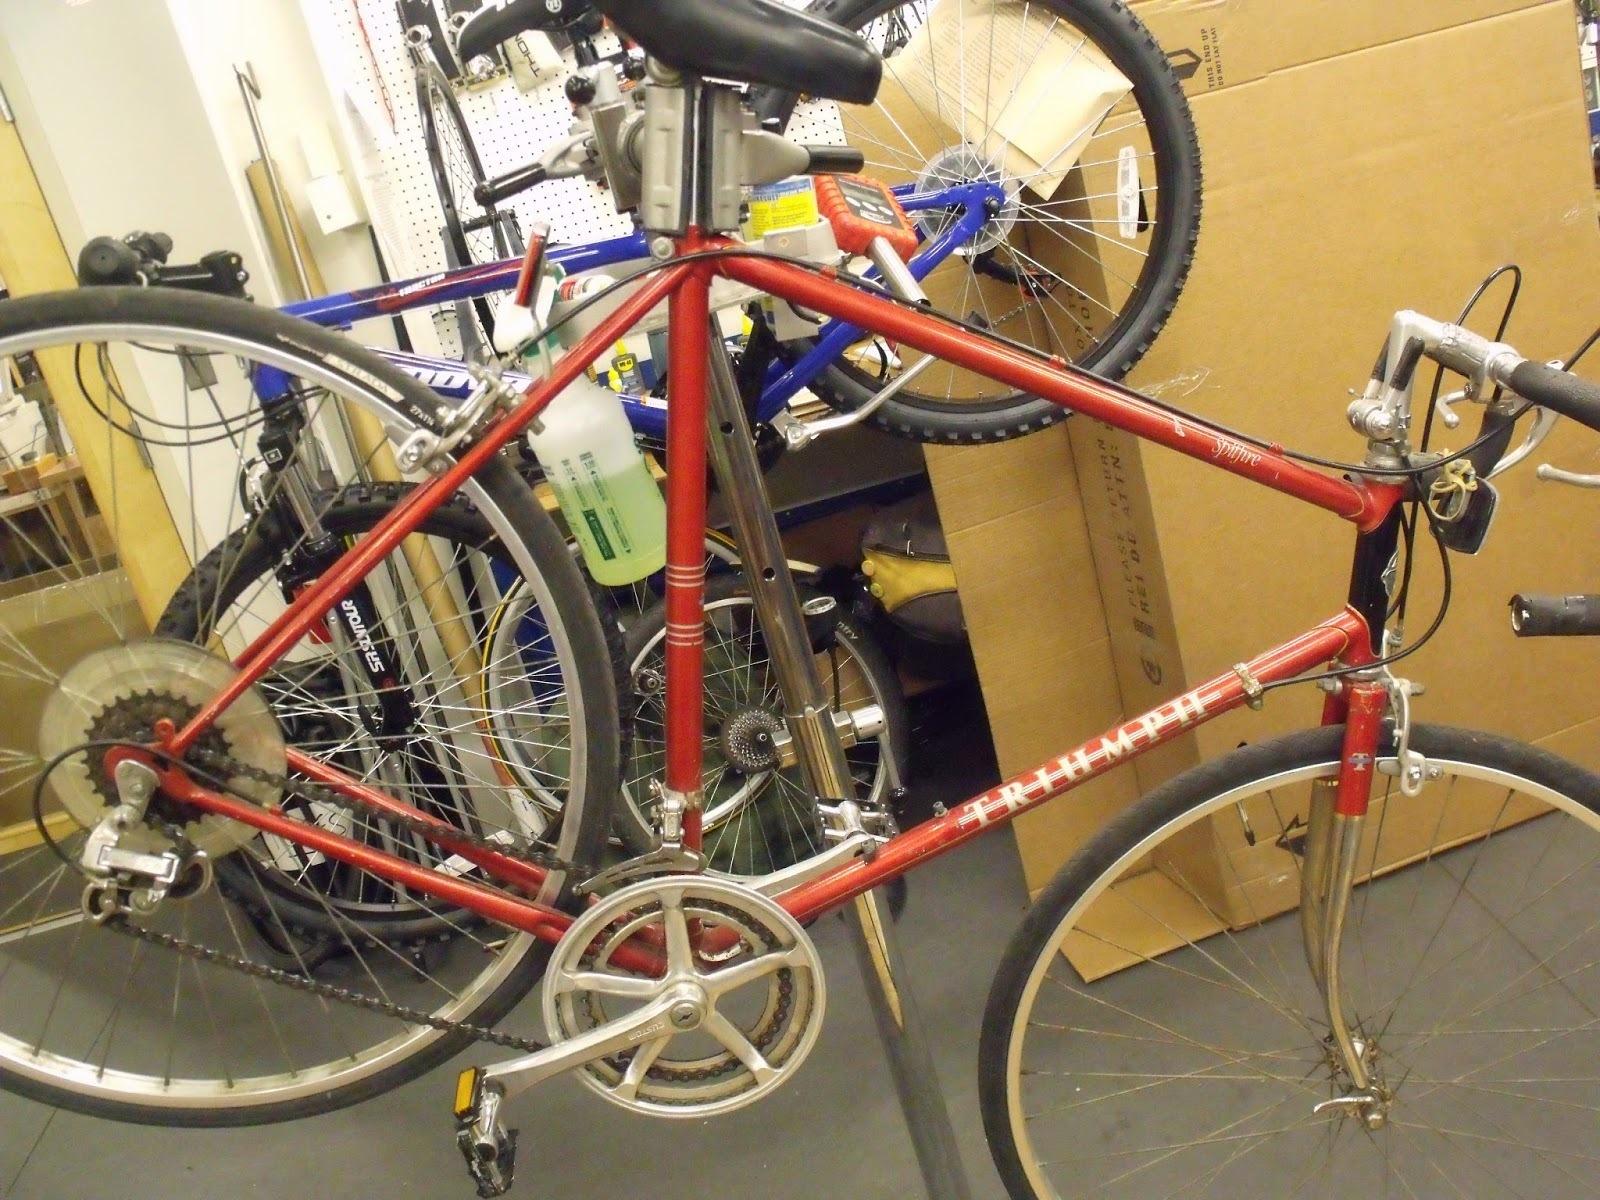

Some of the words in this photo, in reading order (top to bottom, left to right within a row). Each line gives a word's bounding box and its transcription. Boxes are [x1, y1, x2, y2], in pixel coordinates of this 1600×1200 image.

[1200, 28, 1209, 41] UP
[1203, 44, 1212, 63] END
[1212, 46, 1220, 58] LAY
[1206, 67, 1216, 88] THIS
[1217, 77, 1224, 86] DO
[1212, 435, 1262, 467] Spitfire
[1134, 573, 1150, 614] REI
[365, 651, 386, 673] SR
[964, 691, 1208, 828] TRIUMPH
